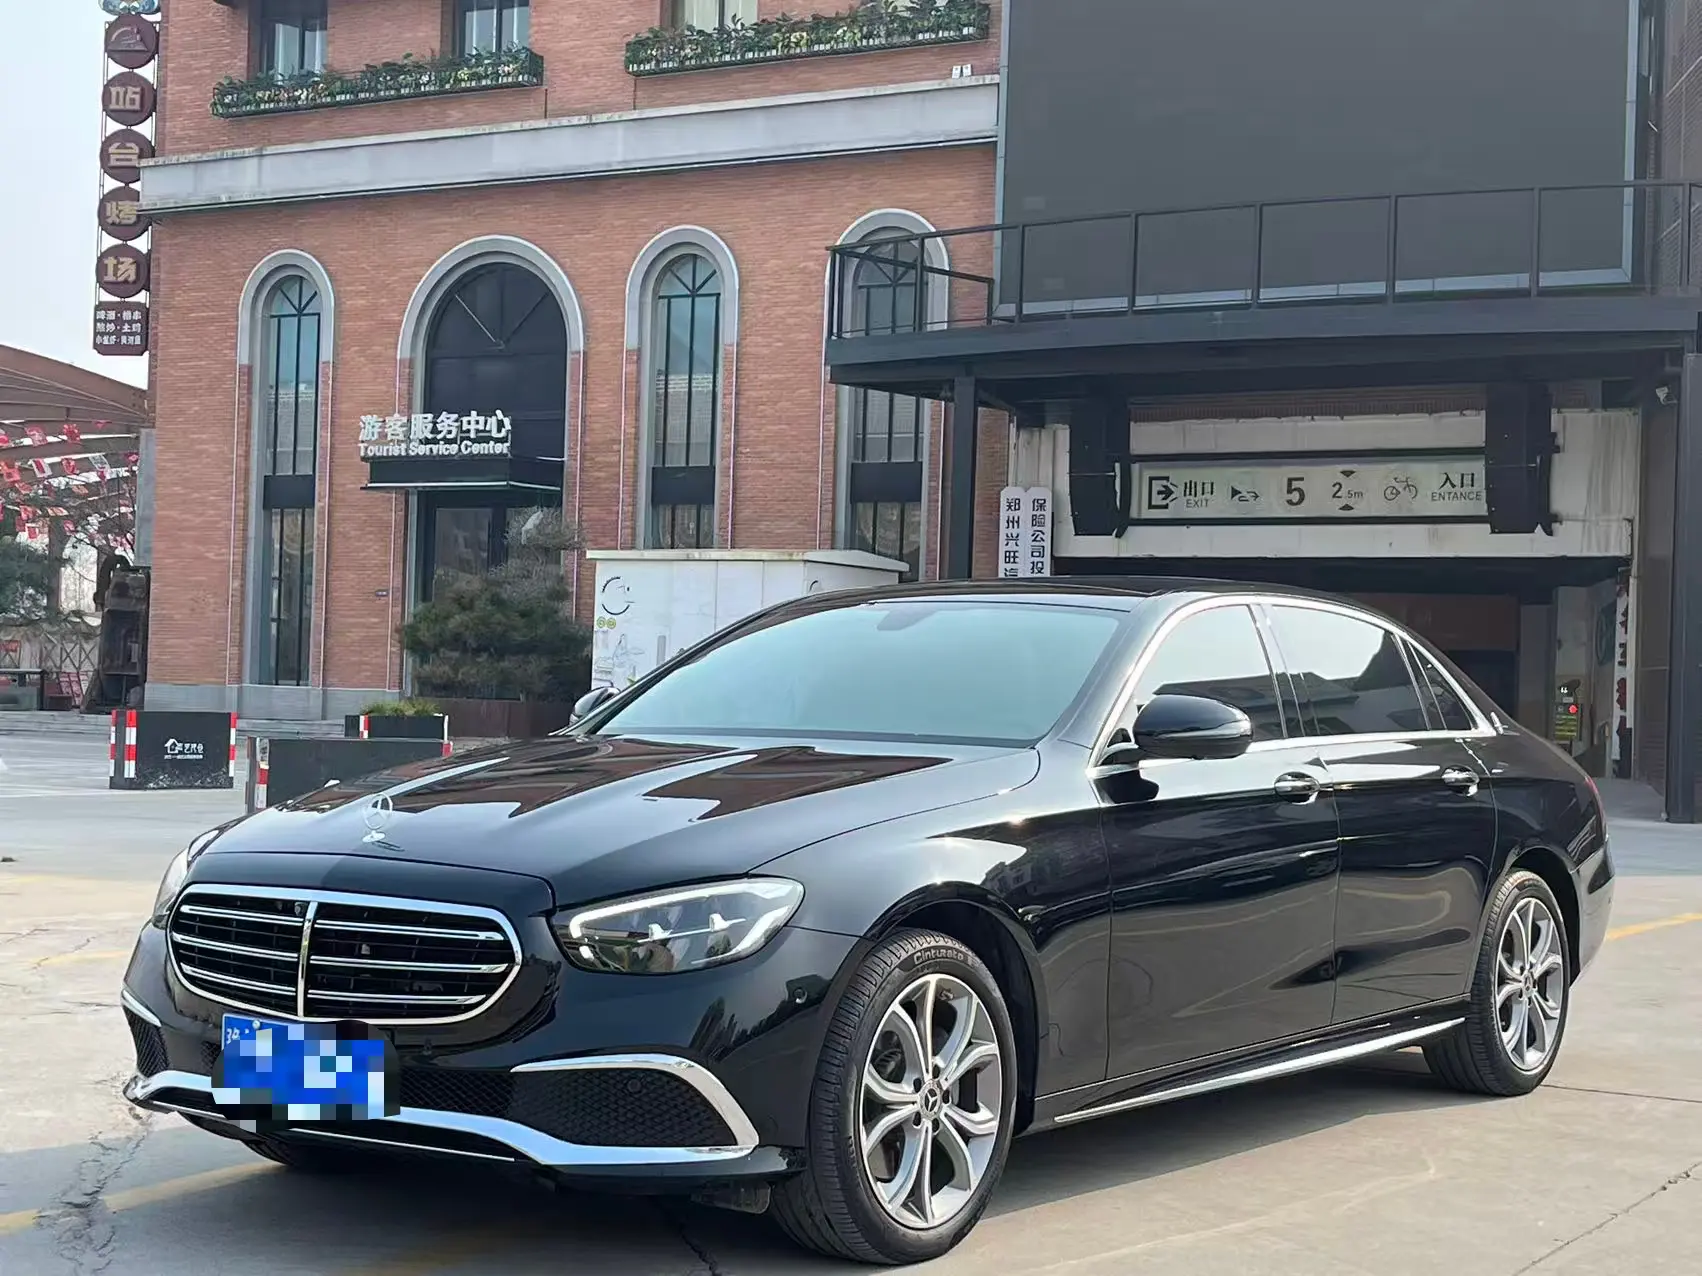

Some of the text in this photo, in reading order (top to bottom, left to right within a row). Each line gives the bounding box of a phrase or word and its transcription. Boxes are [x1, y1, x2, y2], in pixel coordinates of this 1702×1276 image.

[359, 409, 512, 441] 游客服务中心
[358, 440, 511, 457] Tourist Service Center
[1183, 479, 1215, 498] 出口
[1438, 472, 1475, 490] 入口
[1286, 477, 1306, 507] 5
[1430, 490, 1483, 502] ENTANCE
[1185, 498, 1210, 509] EXIT
[1030, 497, 1047, 575] 保险公司投
[913, 948, 964, 965] Cinturato
